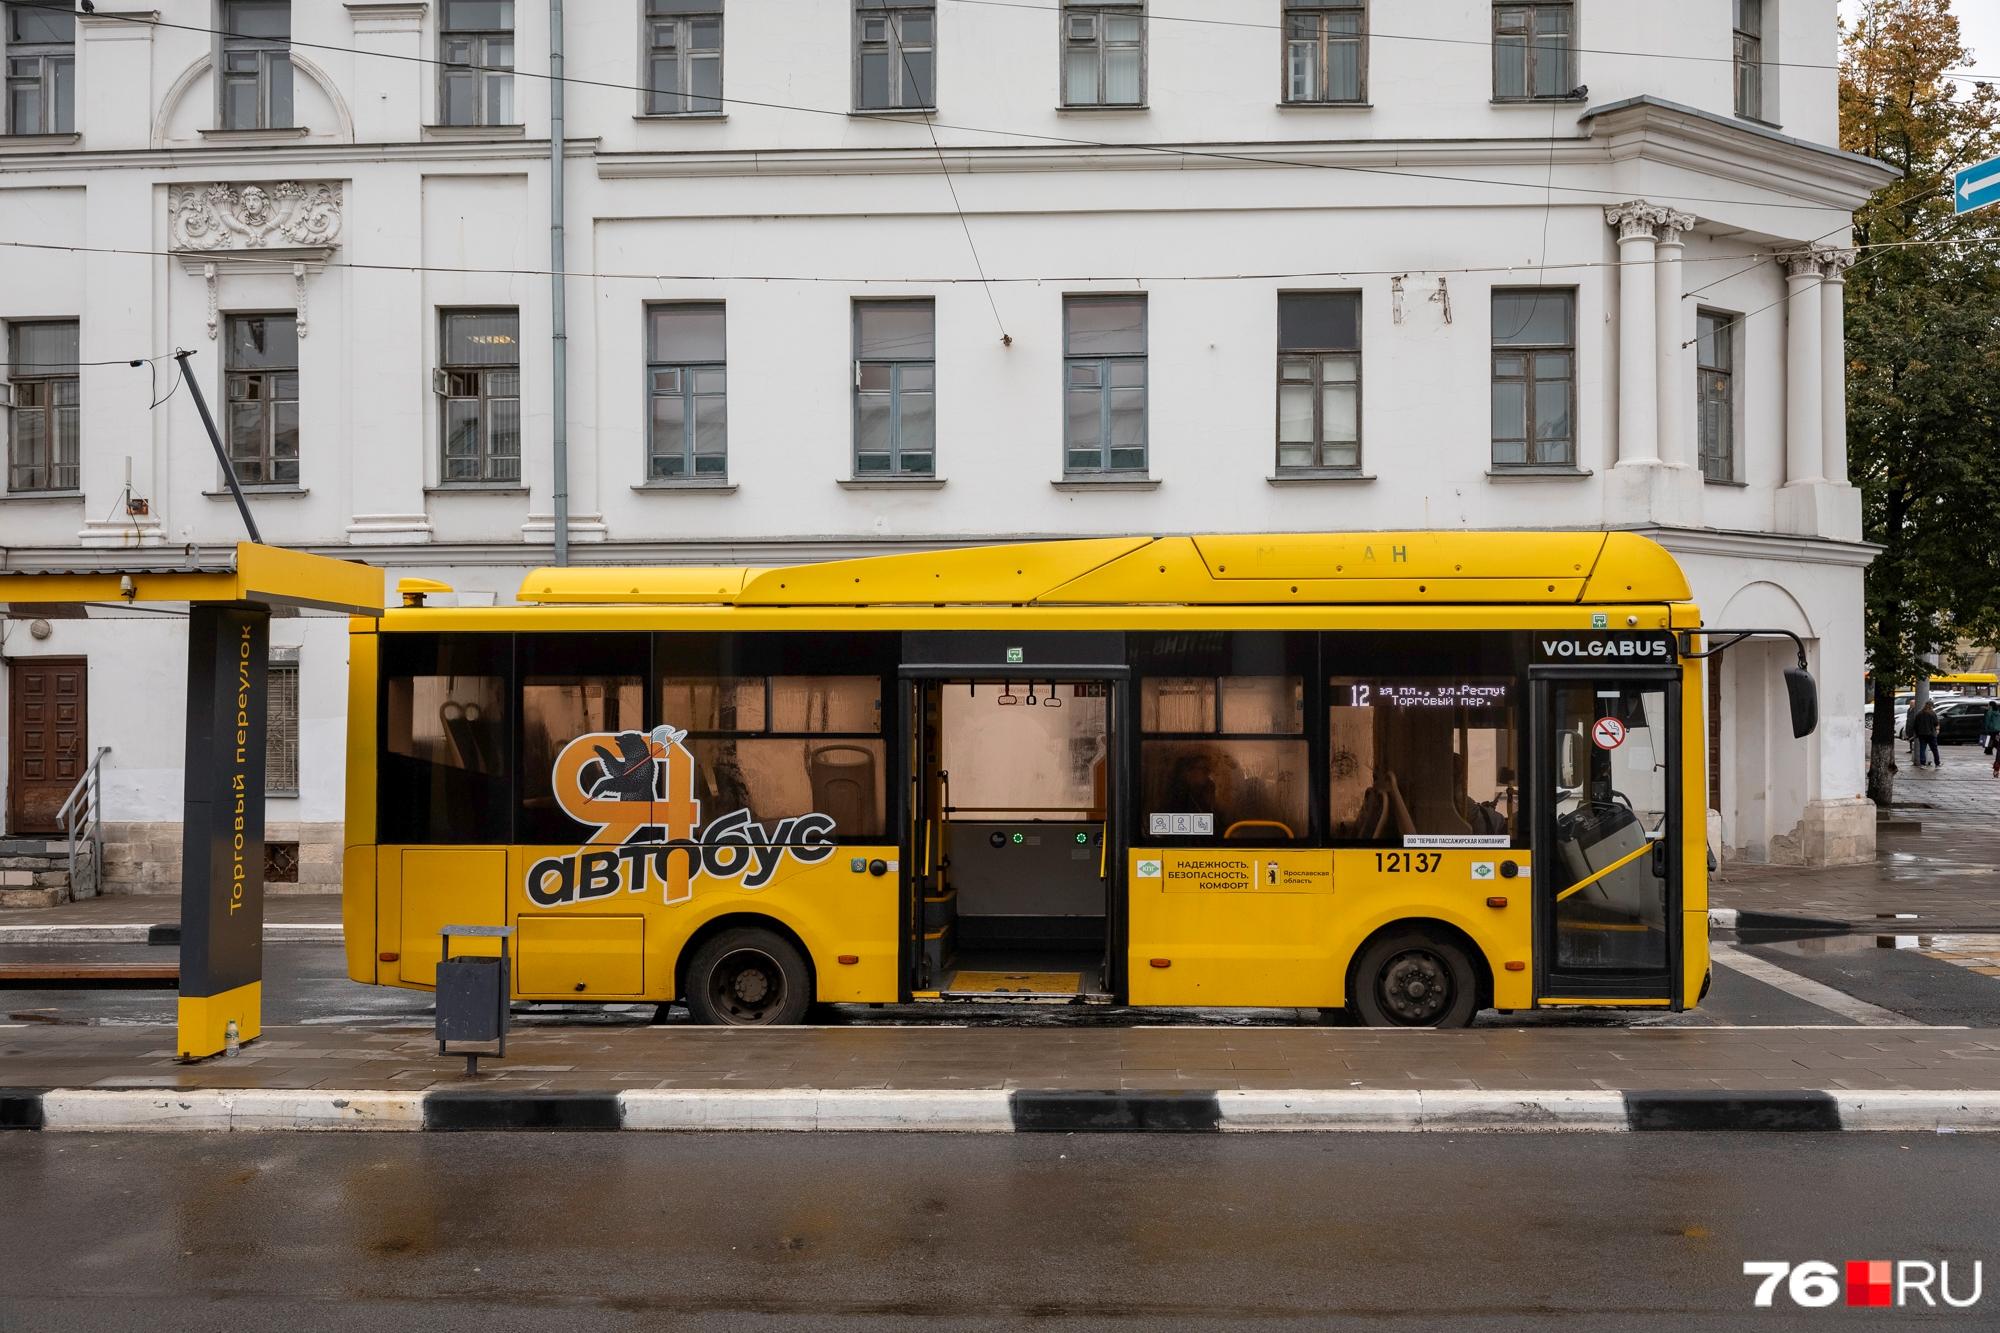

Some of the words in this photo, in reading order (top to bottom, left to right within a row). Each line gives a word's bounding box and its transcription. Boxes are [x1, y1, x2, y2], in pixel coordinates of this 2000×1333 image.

[1542, 640, 1667, 656] VOLGABUS
[236, 624, 252, 762] переулок
[1351, 685, 1370, 707] 12
[1391, 694, 1454, 706] Торговый
[1460, 697, 1492, 707] пер.
[230, 774, 246, 916] Торговый
[525, 807, 837, 908] автобус
[1177, 861, 1249, 870] НАДЕЖНОСТЬ.
[1375, 852, 1442, 873] 12137
[1168, 871, 1249, 879] БЕЗОПАСНОСТЬ.
[1199, 881, 1249, 890] КОМФОРТ
